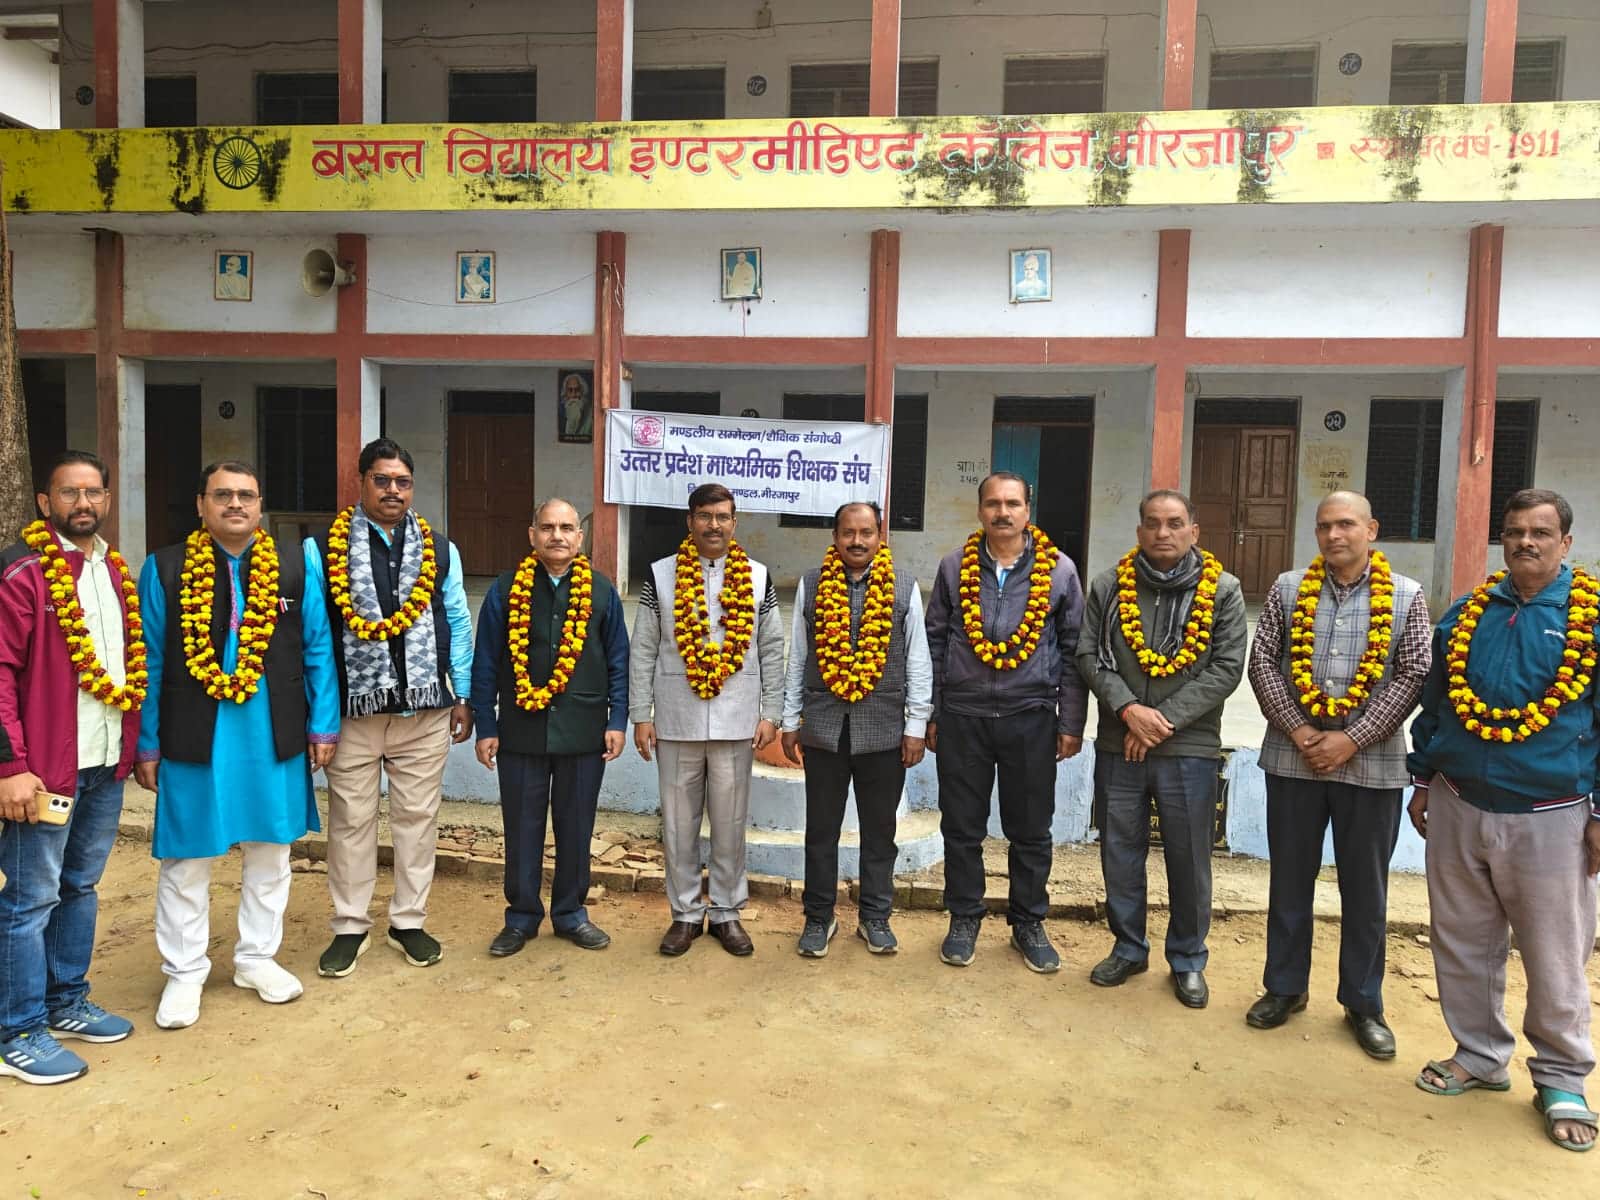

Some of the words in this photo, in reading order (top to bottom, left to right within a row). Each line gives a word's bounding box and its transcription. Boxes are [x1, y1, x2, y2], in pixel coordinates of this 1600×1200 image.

[311, 139, 425, 181] बसन्त
[443, 128, 613, 182] विद्यालय
[629, 119, 924, 180] इण्टरमीडिएट
[1107, 117, 1304, 183] मीरजापुर
[669, 425, 715, 439] मण्डलीय
[803, 430, 842, 445] संगोष्ठी
[620, 449, 662, 474] उत्तर
[664, 444, 704, 478] प्रदेश
[706, 448, 783, 480] माध्यमिक
[787, 449, 840, 483] शिक्षक
[842, 453, 872, 485] संघ
